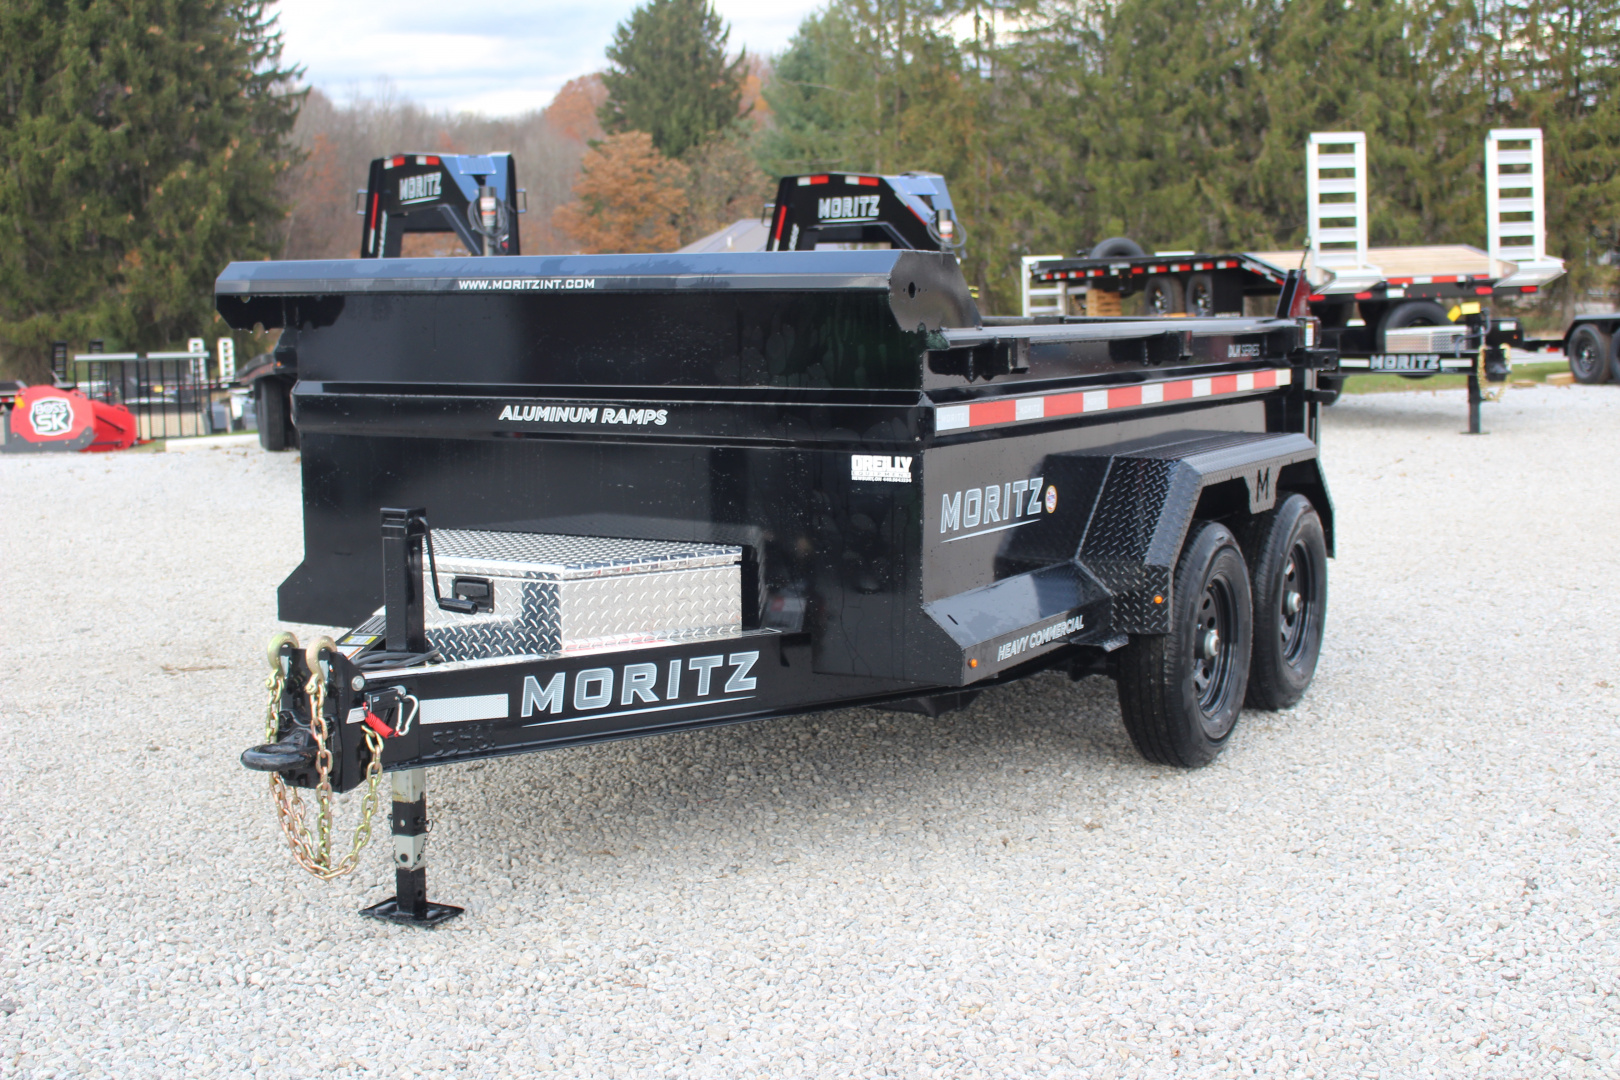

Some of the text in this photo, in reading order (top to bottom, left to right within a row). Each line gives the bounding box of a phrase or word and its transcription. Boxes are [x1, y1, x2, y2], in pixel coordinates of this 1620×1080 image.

[400, 172, 442, 200] MORITZ
[818, 195, 880, 218] MORITZ
[458, 279, 595, 289] WWW.MORITZINT.COM
[1370, 355, 1440, 369] MORITZ
[35, 402, 67, 415] BOSS
[499, 405, 668, 425] ALUMINUM RAMPS
[35, 413, 69, 432] SK
[940, 477, 1044, 533] MORITZ
[997, 615, 1085, 662] HEAVY COMMERCIAL
[521, 651, 760, 718] MORITZ
